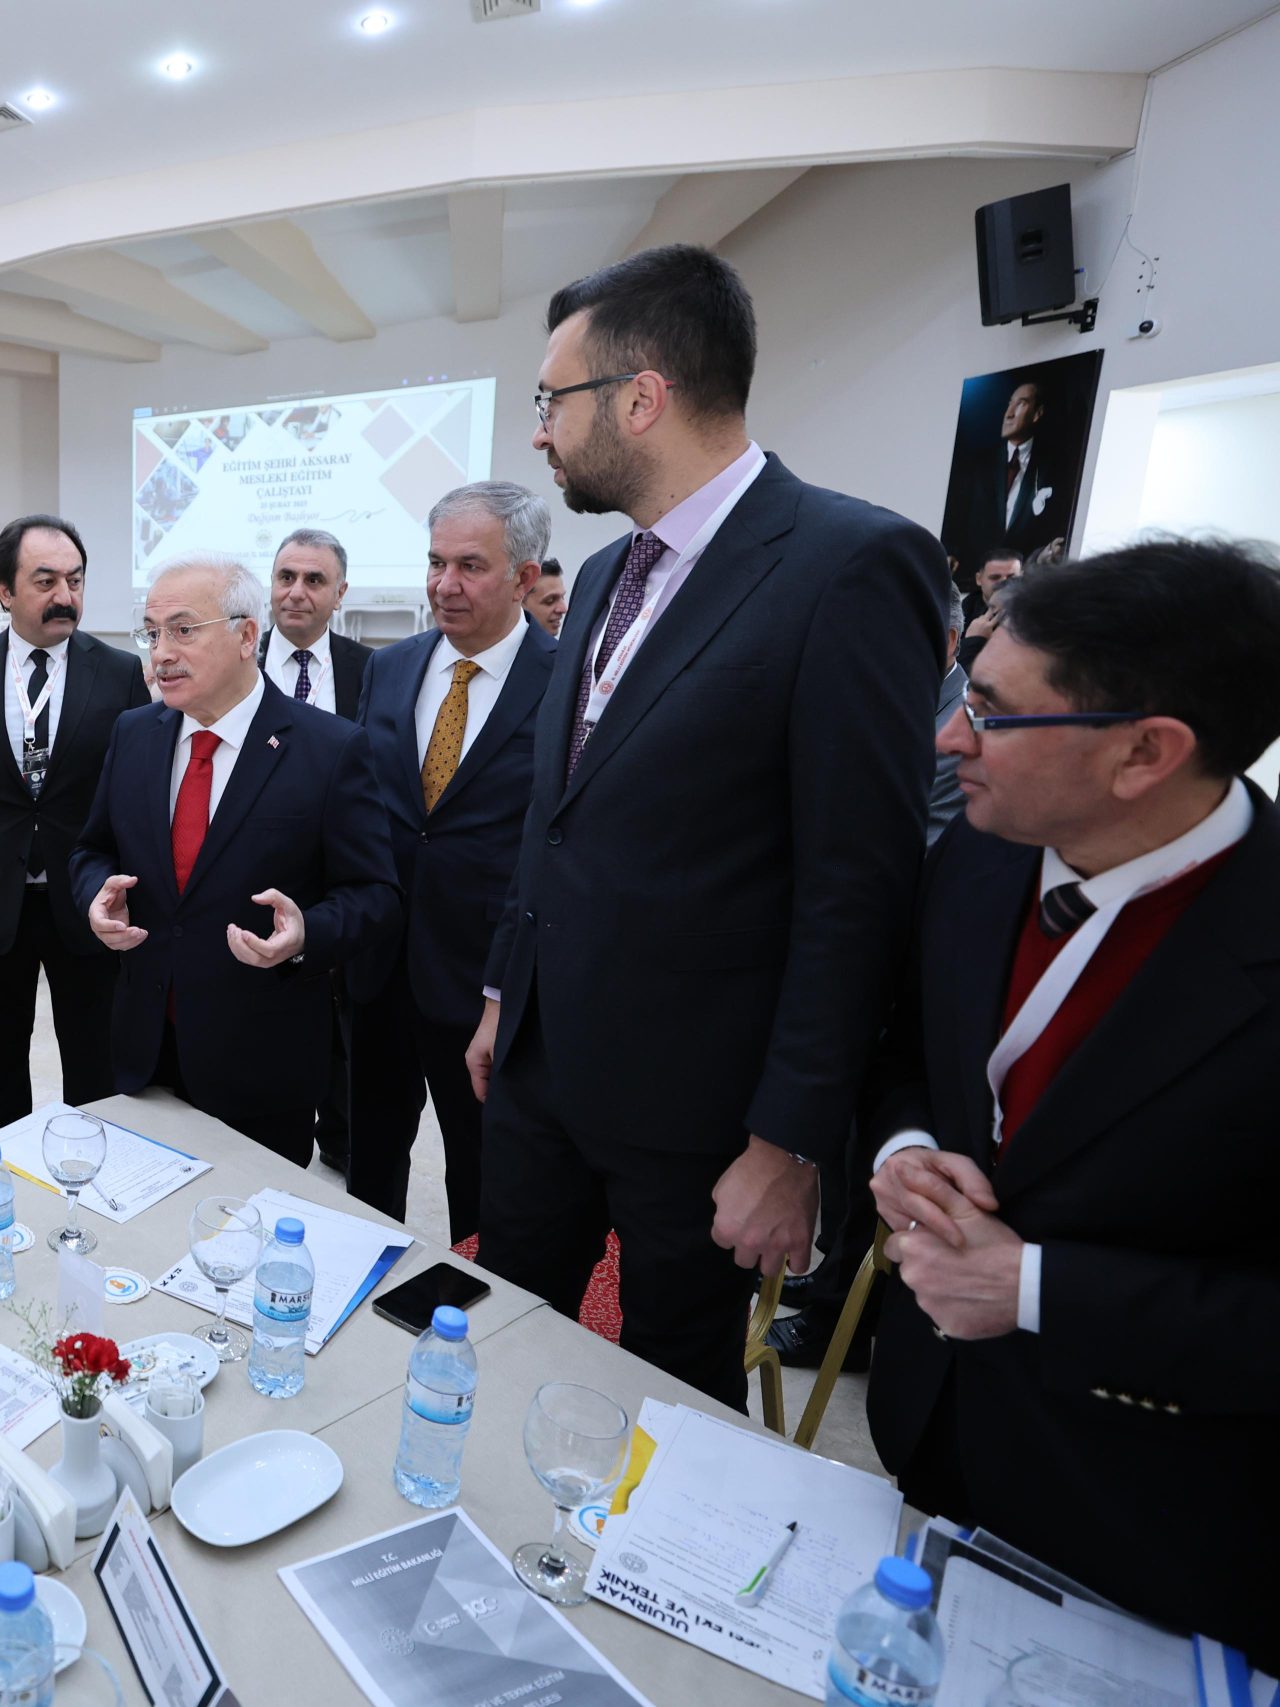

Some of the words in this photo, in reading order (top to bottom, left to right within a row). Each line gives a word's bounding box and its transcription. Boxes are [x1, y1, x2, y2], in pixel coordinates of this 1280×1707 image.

[222, 459, 261, 473] EĞİTİM
[264, 456, 297, 472] ŞEHRİ
[301, 453, 352, 467] AKSARAY
[256, 484, 313, 499] ÇALIŞTAYI
[599, 1567, 660, 1604] TEKNİK
[595, 1580, 690, 1634] ULUIRMAK
[665, 1601, 689, 1618] VE
